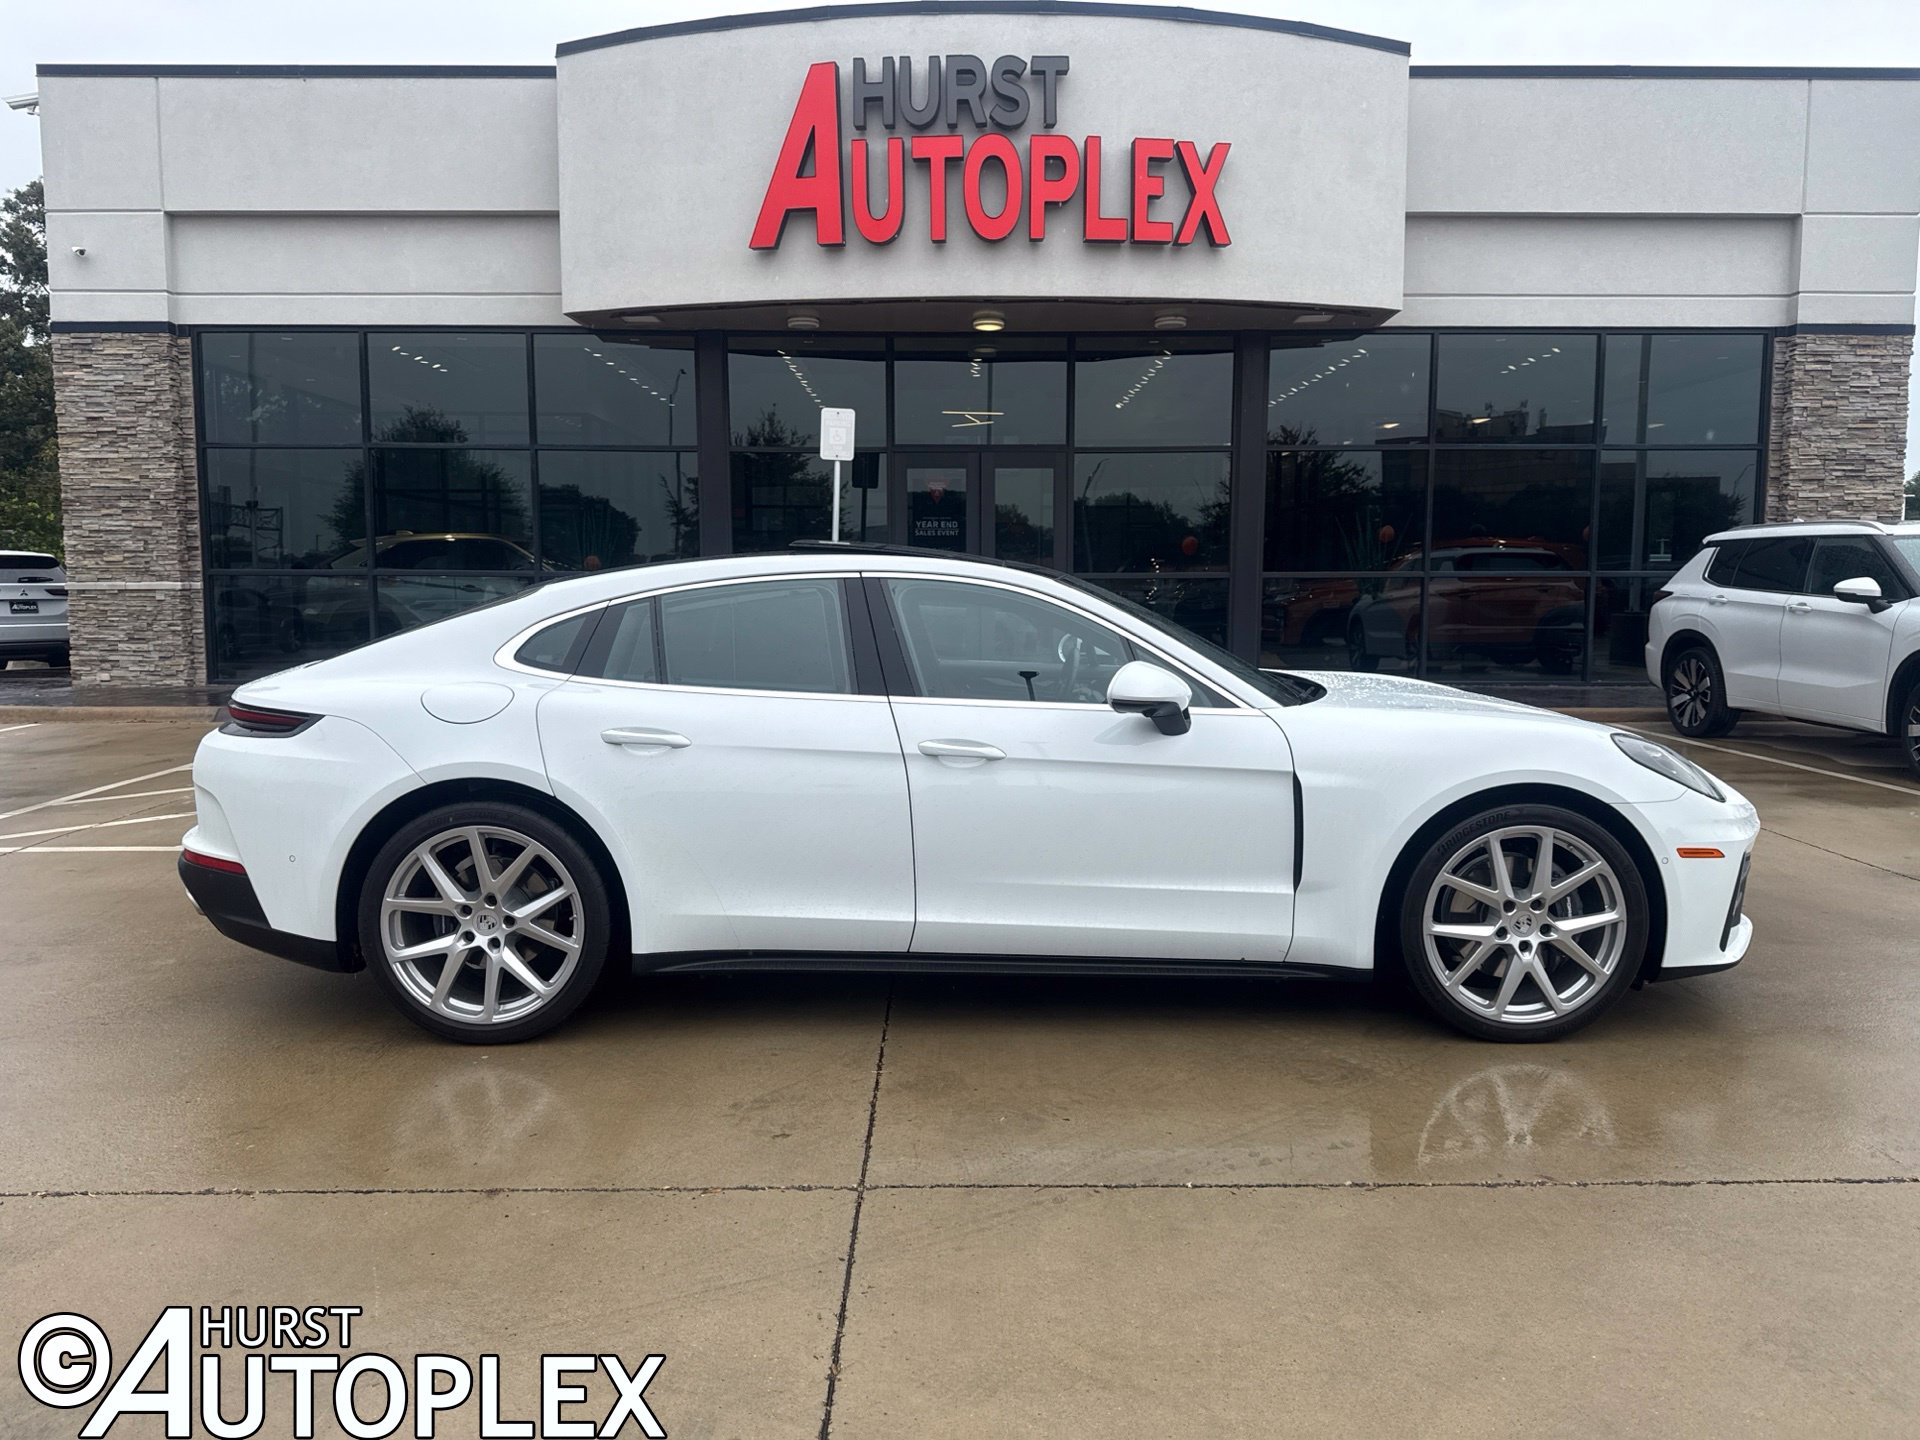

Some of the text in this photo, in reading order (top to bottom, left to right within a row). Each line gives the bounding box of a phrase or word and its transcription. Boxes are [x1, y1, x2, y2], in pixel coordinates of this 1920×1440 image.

[852, 54, 1070, 131] HURST
[749, 61, 1232, 249] AUTOPLEX
[914, 529, 960, 537] SALES EVENT
[915, 520, 959, 528] YEAR END
